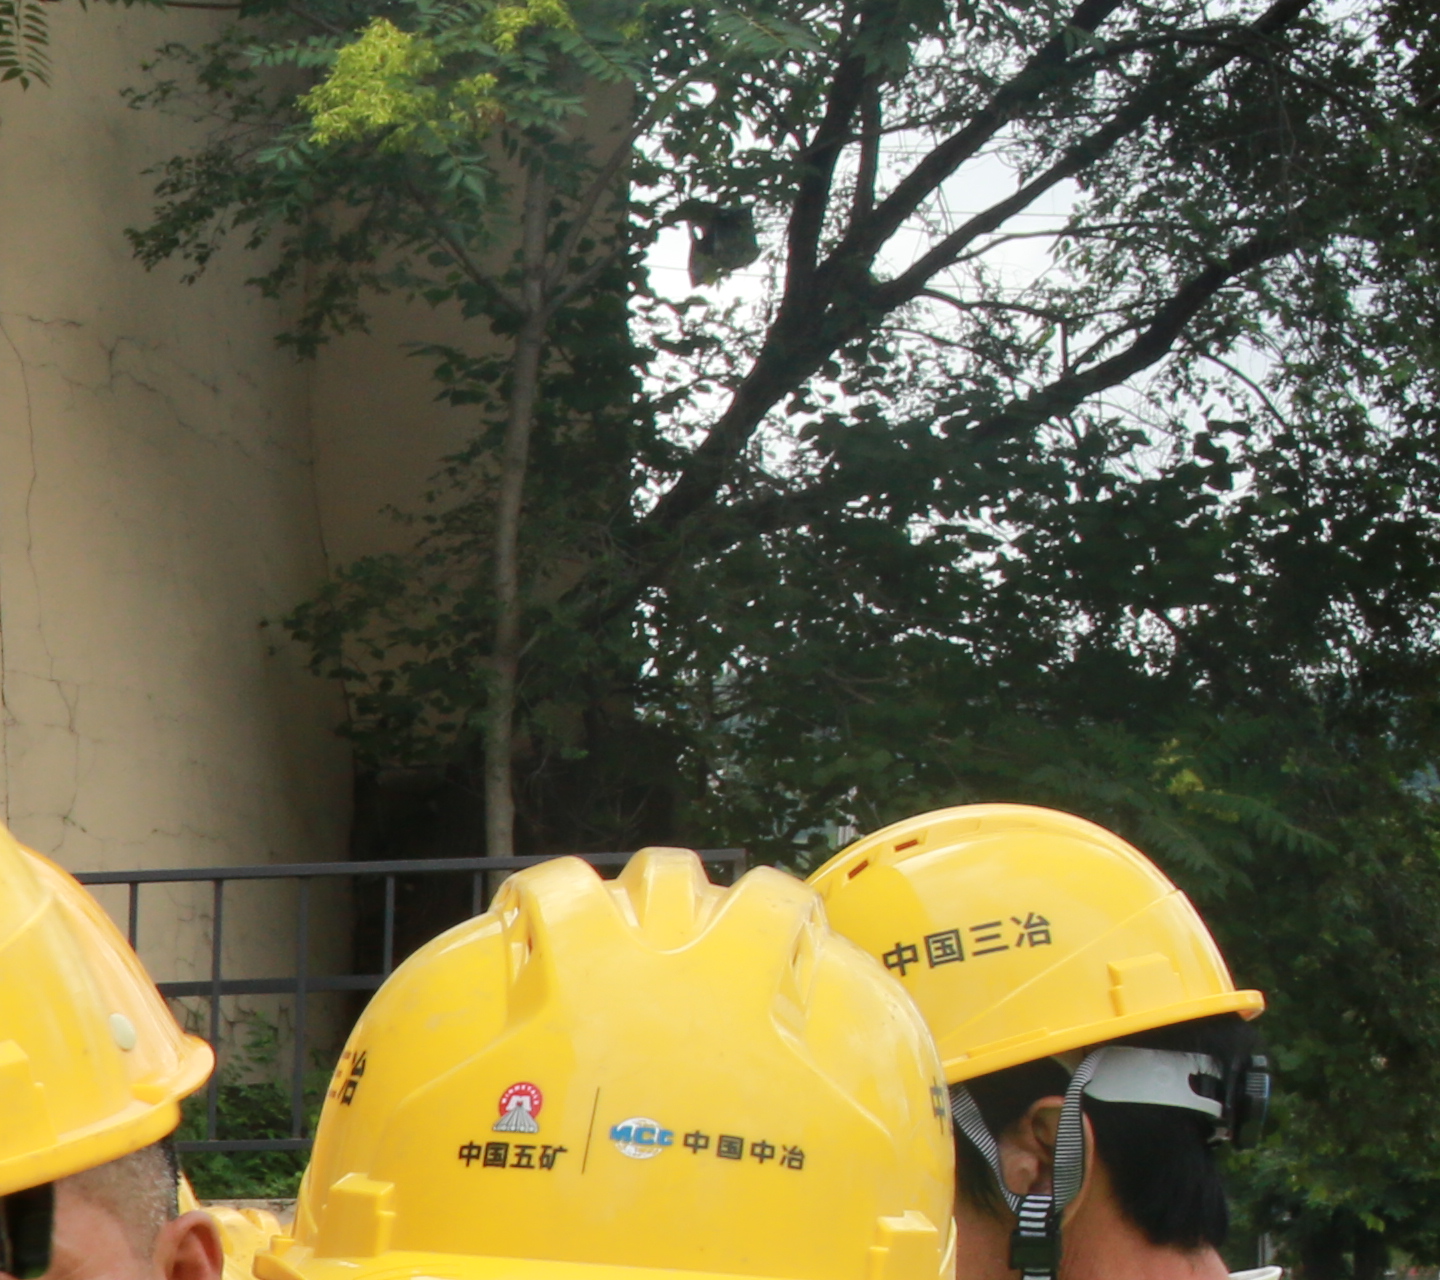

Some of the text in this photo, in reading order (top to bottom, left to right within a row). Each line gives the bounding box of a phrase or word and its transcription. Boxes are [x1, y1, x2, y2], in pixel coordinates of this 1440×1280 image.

[882, 912, 1052, 977] 中国三冶
[609, 1125, 674, 1147] MCC
[683, 1130, 805, 1170] 中国中冶
[458, 1141, 568, 1171] 中国五矿
